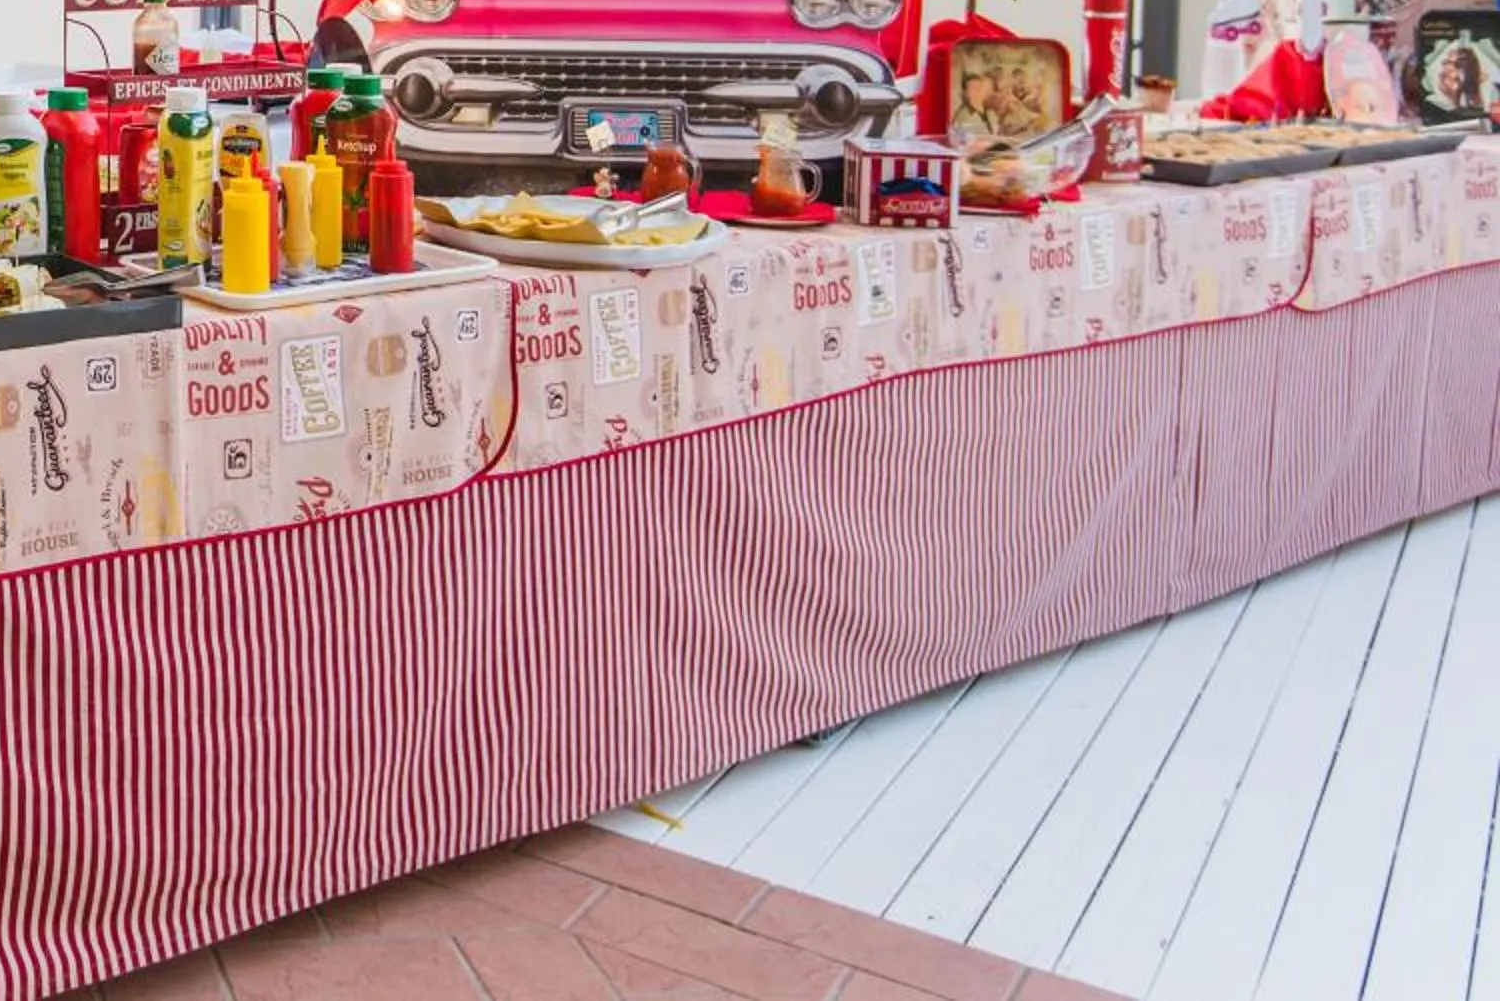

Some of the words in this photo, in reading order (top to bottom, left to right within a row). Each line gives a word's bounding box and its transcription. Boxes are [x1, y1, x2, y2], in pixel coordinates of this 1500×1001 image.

[114, 80, 169, 100] EPICES
[203, 71, 304, 93] CONDIMENTS
[337, 139, 377, 155] Ketchup
[184, 315, 268, 351] QUALITY
[515, 325, 583, 364] GOODS
[218, 350, 236, 376] &
[187, 375, 270, 417] GOODS
[25, 365, 70, 493] Guaranteed
[21, 531, 80, 557] HOUSE
